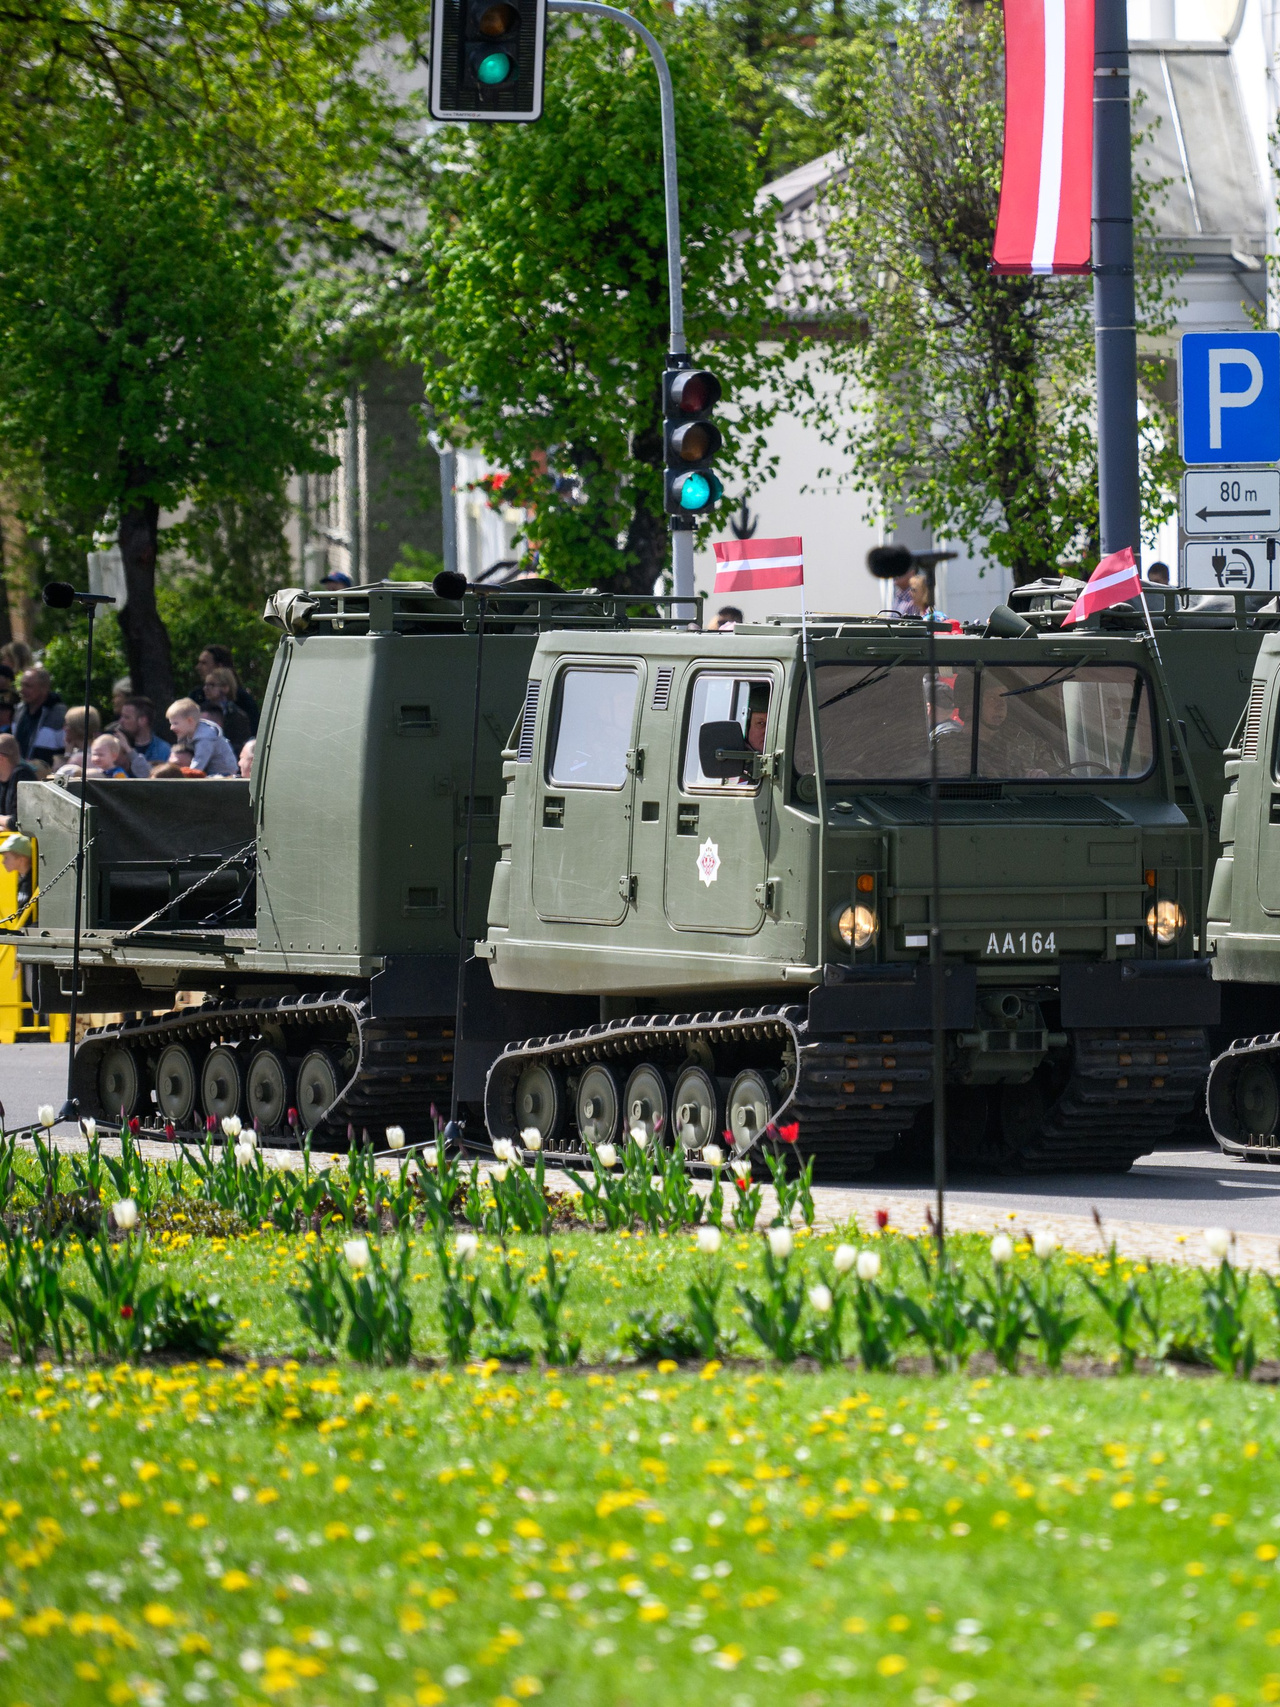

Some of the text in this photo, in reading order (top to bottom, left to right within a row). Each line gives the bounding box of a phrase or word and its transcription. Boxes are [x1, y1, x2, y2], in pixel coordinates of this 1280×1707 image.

[1208, 348, 1264, 449] P
[1220, 481, 1258, 502] 80 m
[986, 931, 1056, 954] AA164
